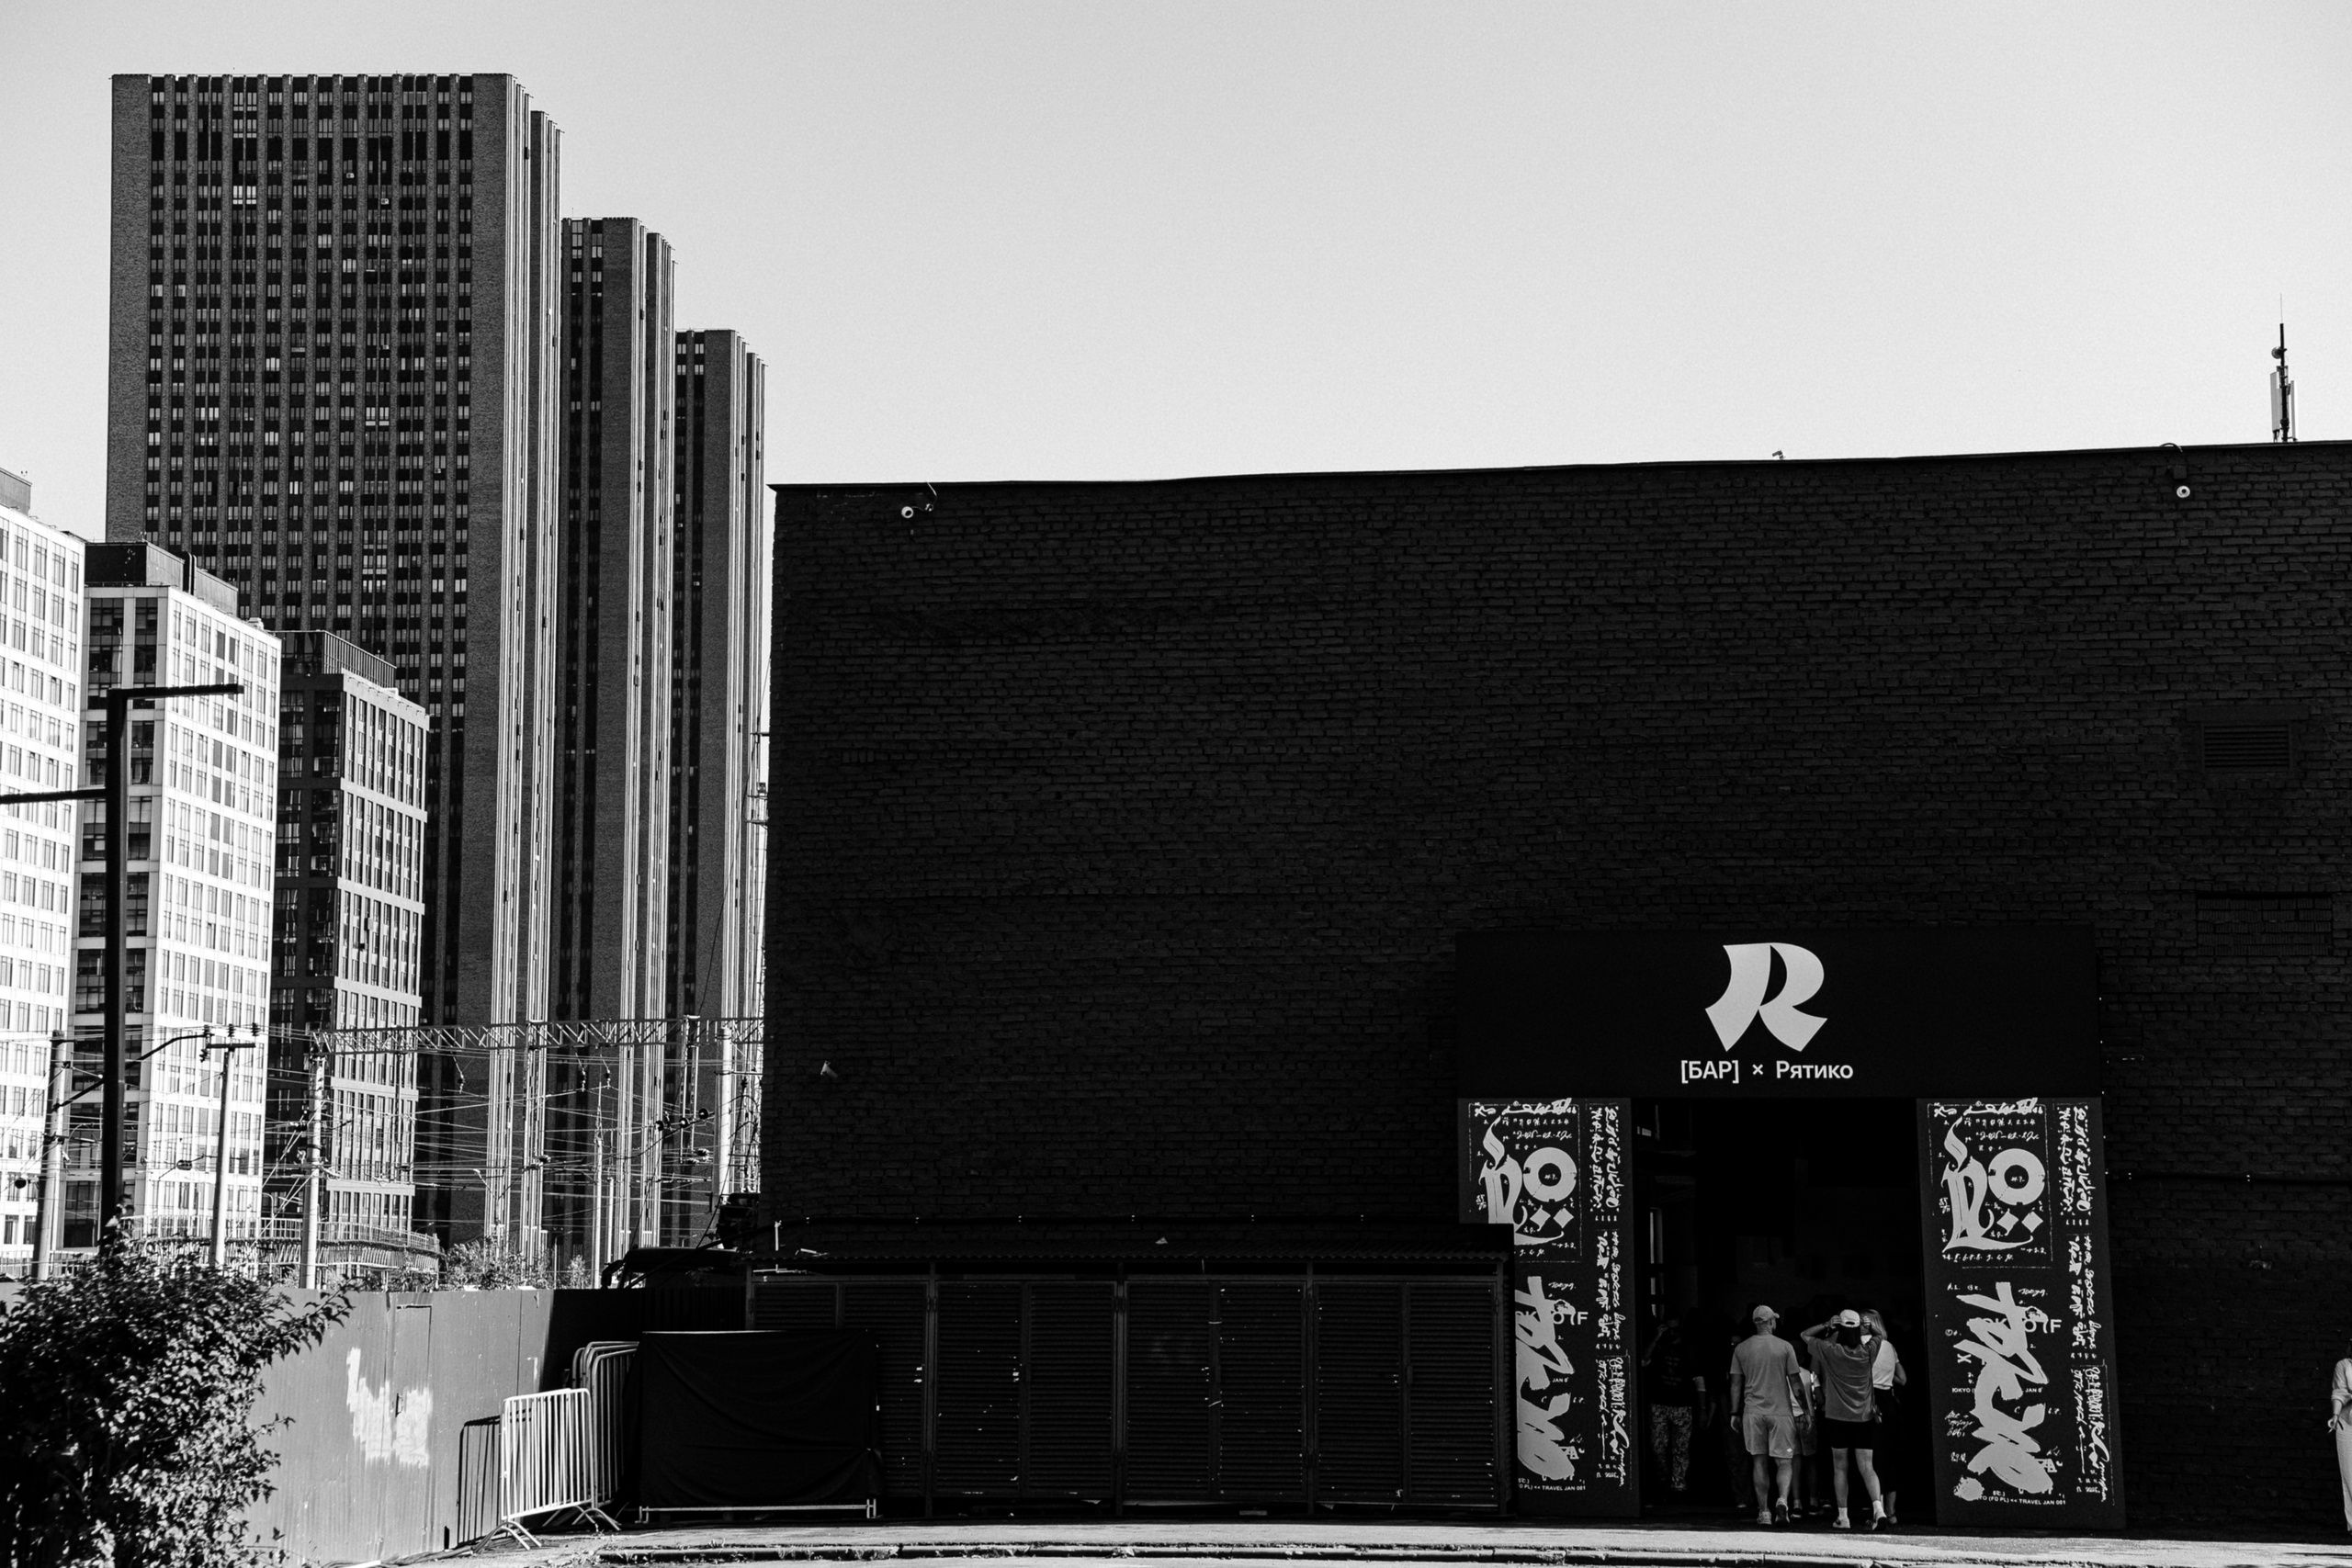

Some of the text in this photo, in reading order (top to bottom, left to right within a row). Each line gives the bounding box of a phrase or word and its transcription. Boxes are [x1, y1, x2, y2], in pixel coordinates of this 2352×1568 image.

[1681, 1060, 1739, 1084] [БАР]
[1776, 1060, 1854, 1079] Рятико
[2018, 1497, 2042, 1506] TRAVEL
